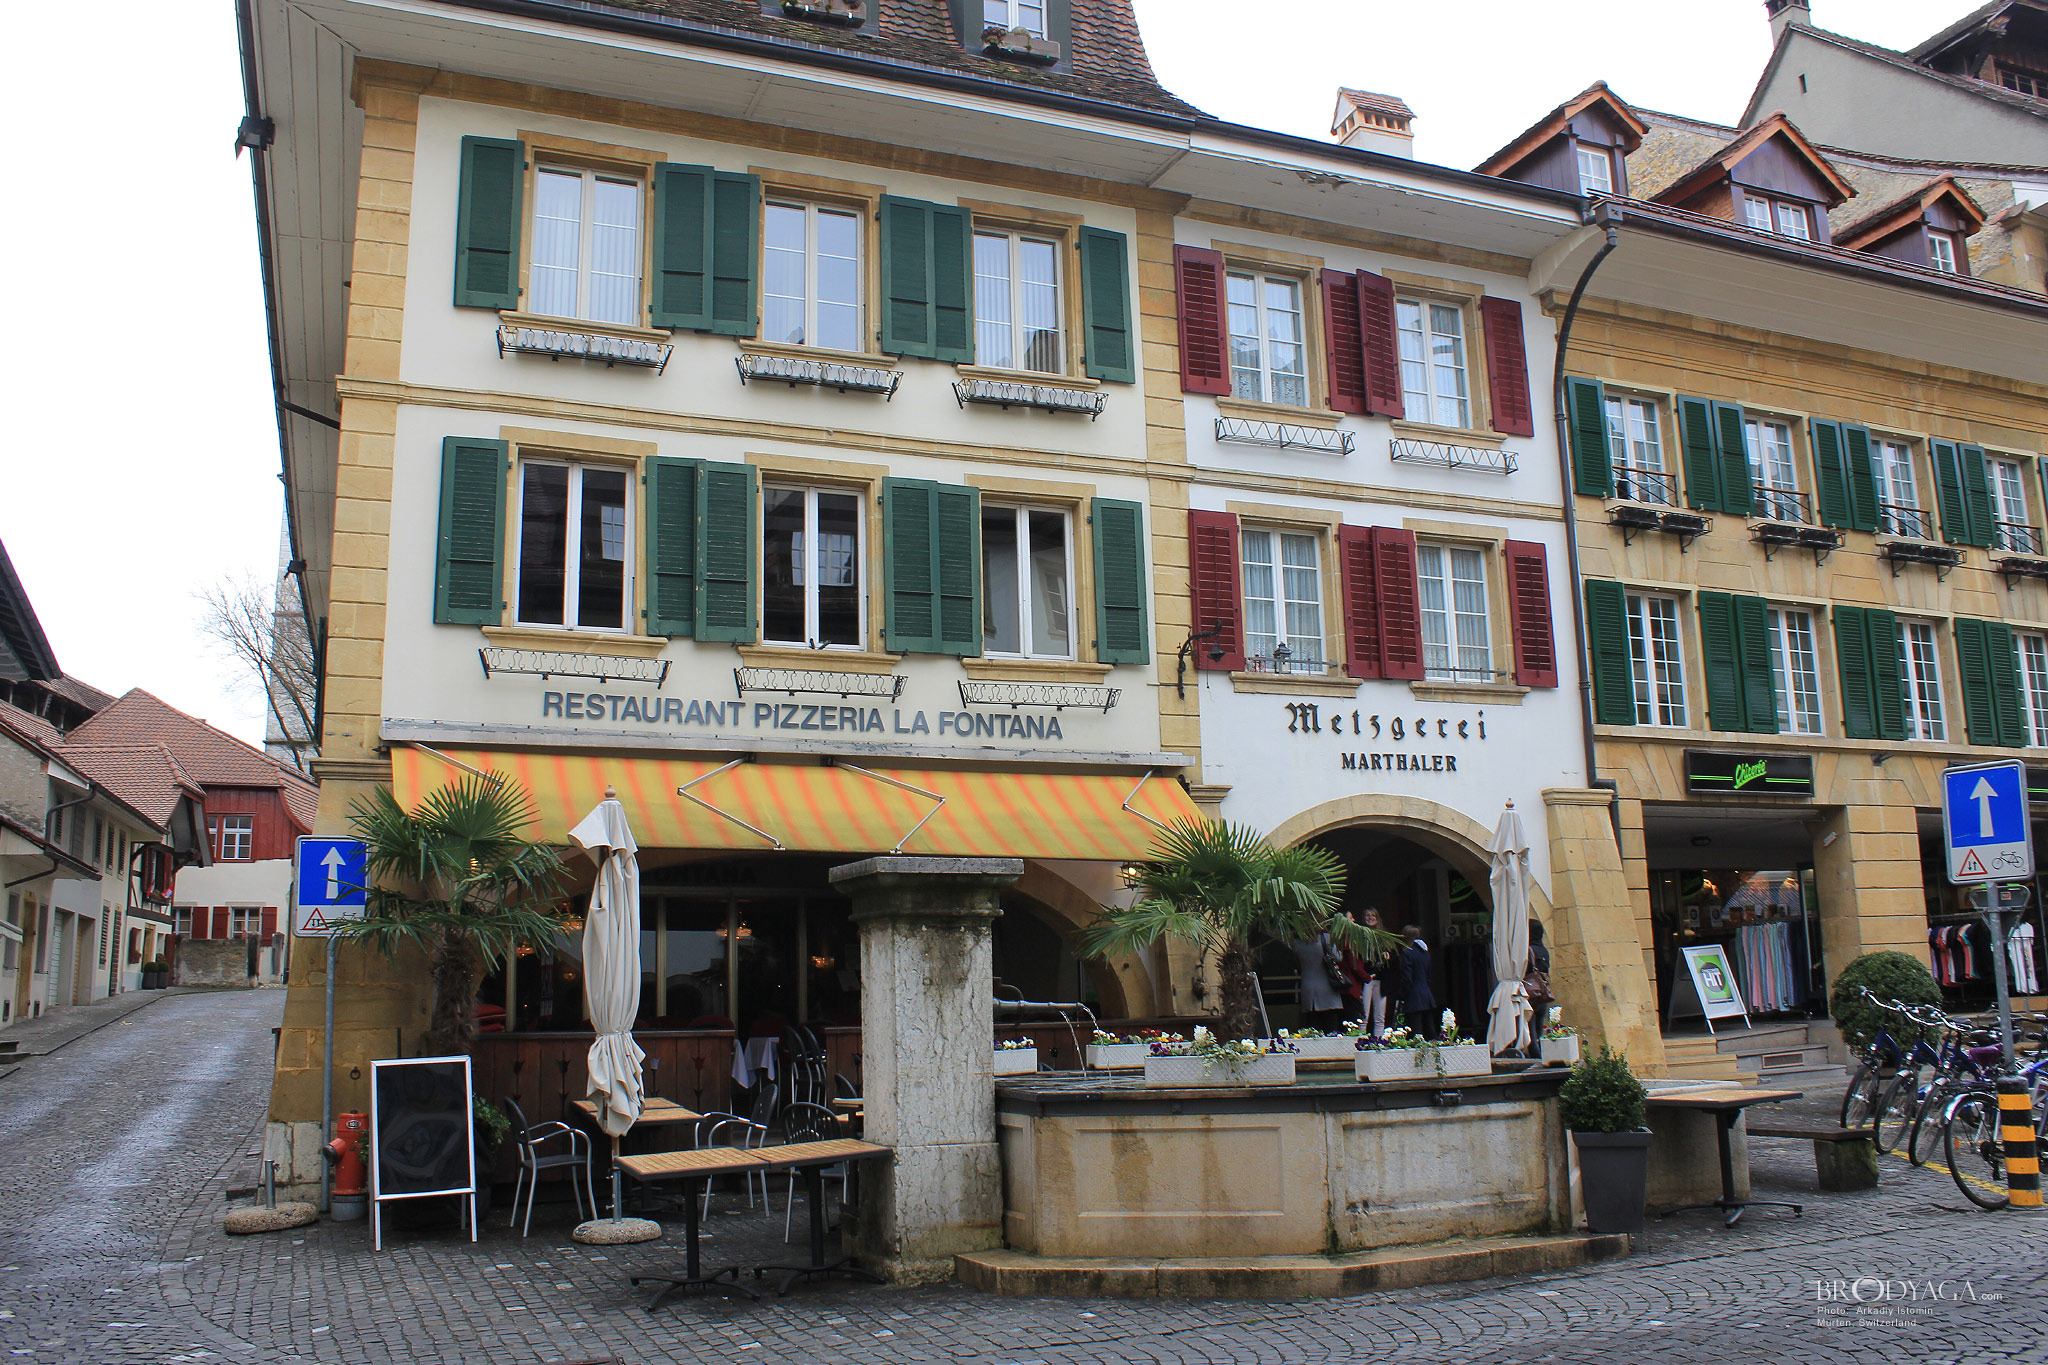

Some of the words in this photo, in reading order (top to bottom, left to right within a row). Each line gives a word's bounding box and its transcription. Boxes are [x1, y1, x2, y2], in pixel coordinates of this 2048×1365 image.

[543, 691, 746, 726] RESTAURANT
[754, 702, 885, 732] PIZZERIA
[894, 708, 930, 734] LA
[939, 711, 1063, 740] FONTANA
[1285, 702, 1487, 741] Metzgerei
[1341, 752, 1457, 772] MARTHALER
